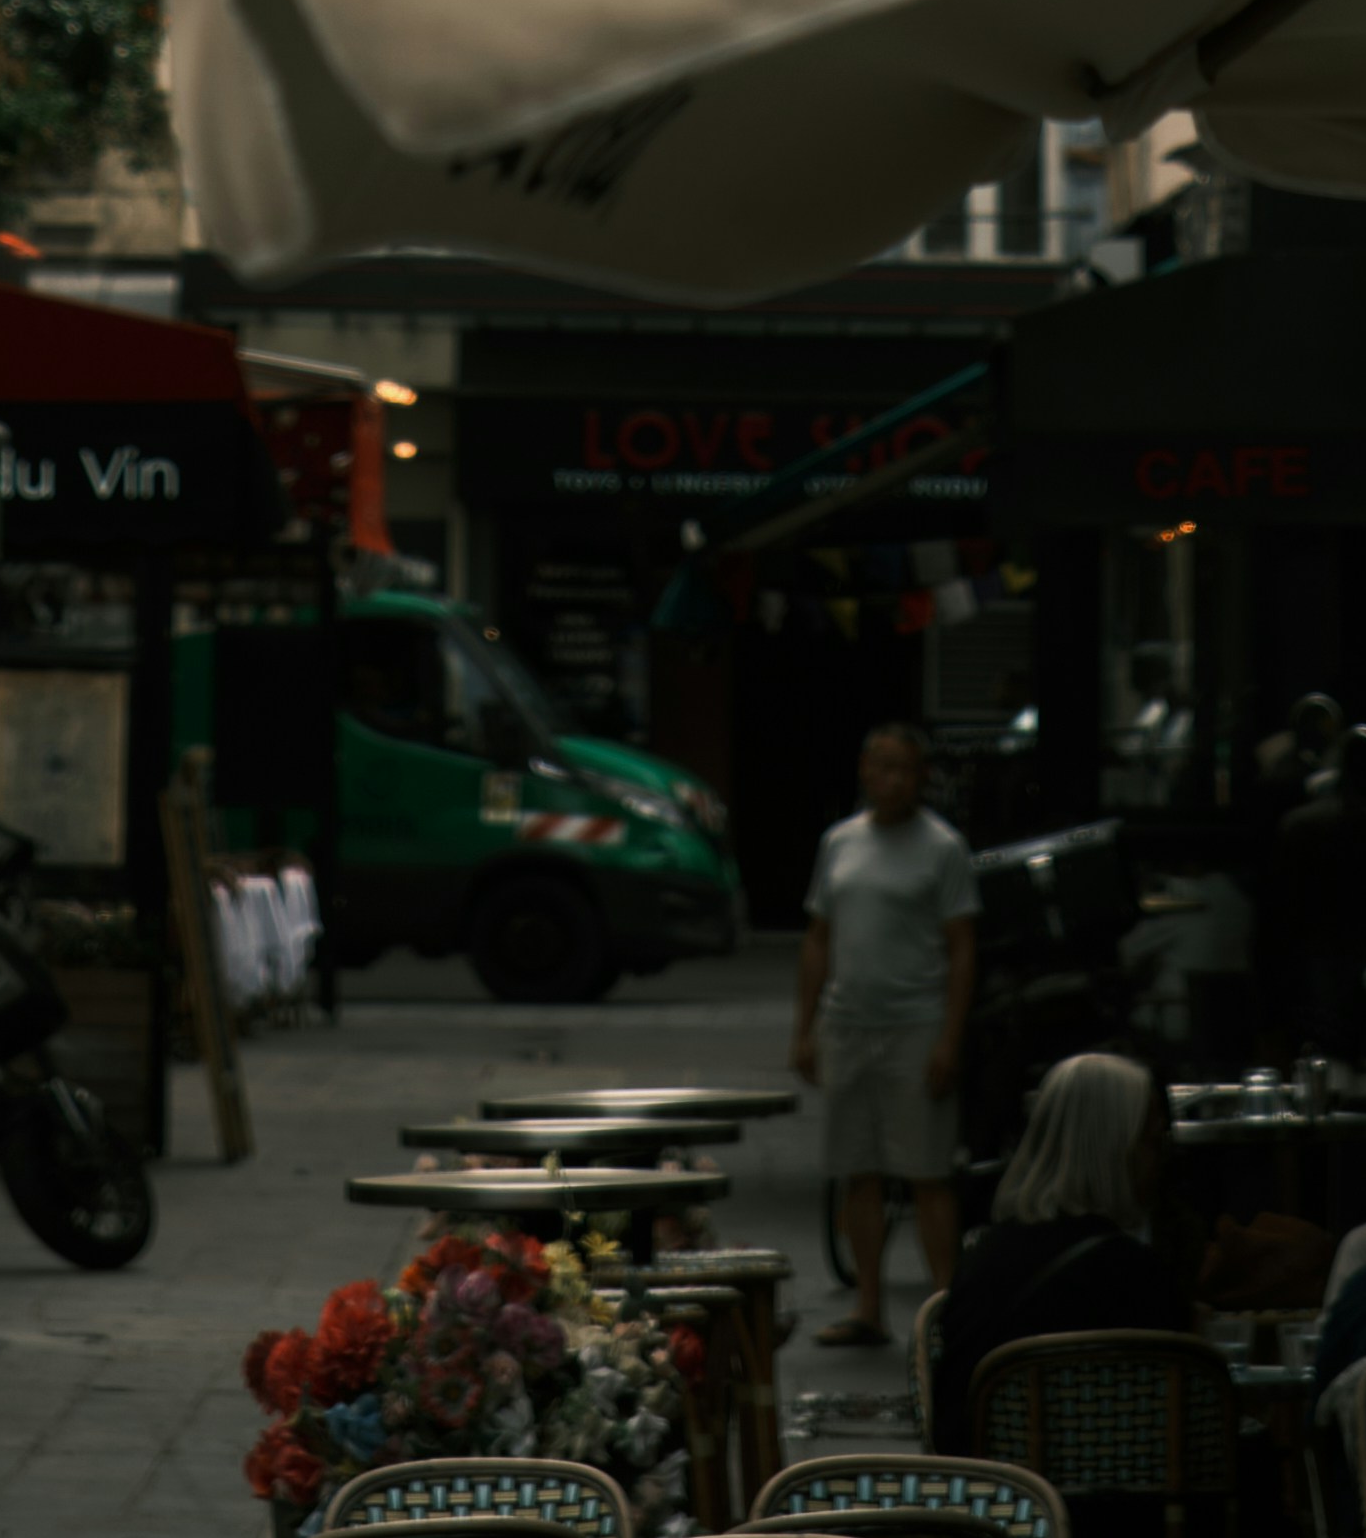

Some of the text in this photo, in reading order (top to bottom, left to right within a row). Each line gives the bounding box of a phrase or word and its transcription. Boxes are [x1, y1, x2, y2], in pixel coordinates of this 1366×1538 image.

[583, 409, 776, 473] LOVE
[79, 445, 181, 501] Vin
[552, 467, 623, 495] TOYS
[1135, 444, 1312, 501] CAFE
